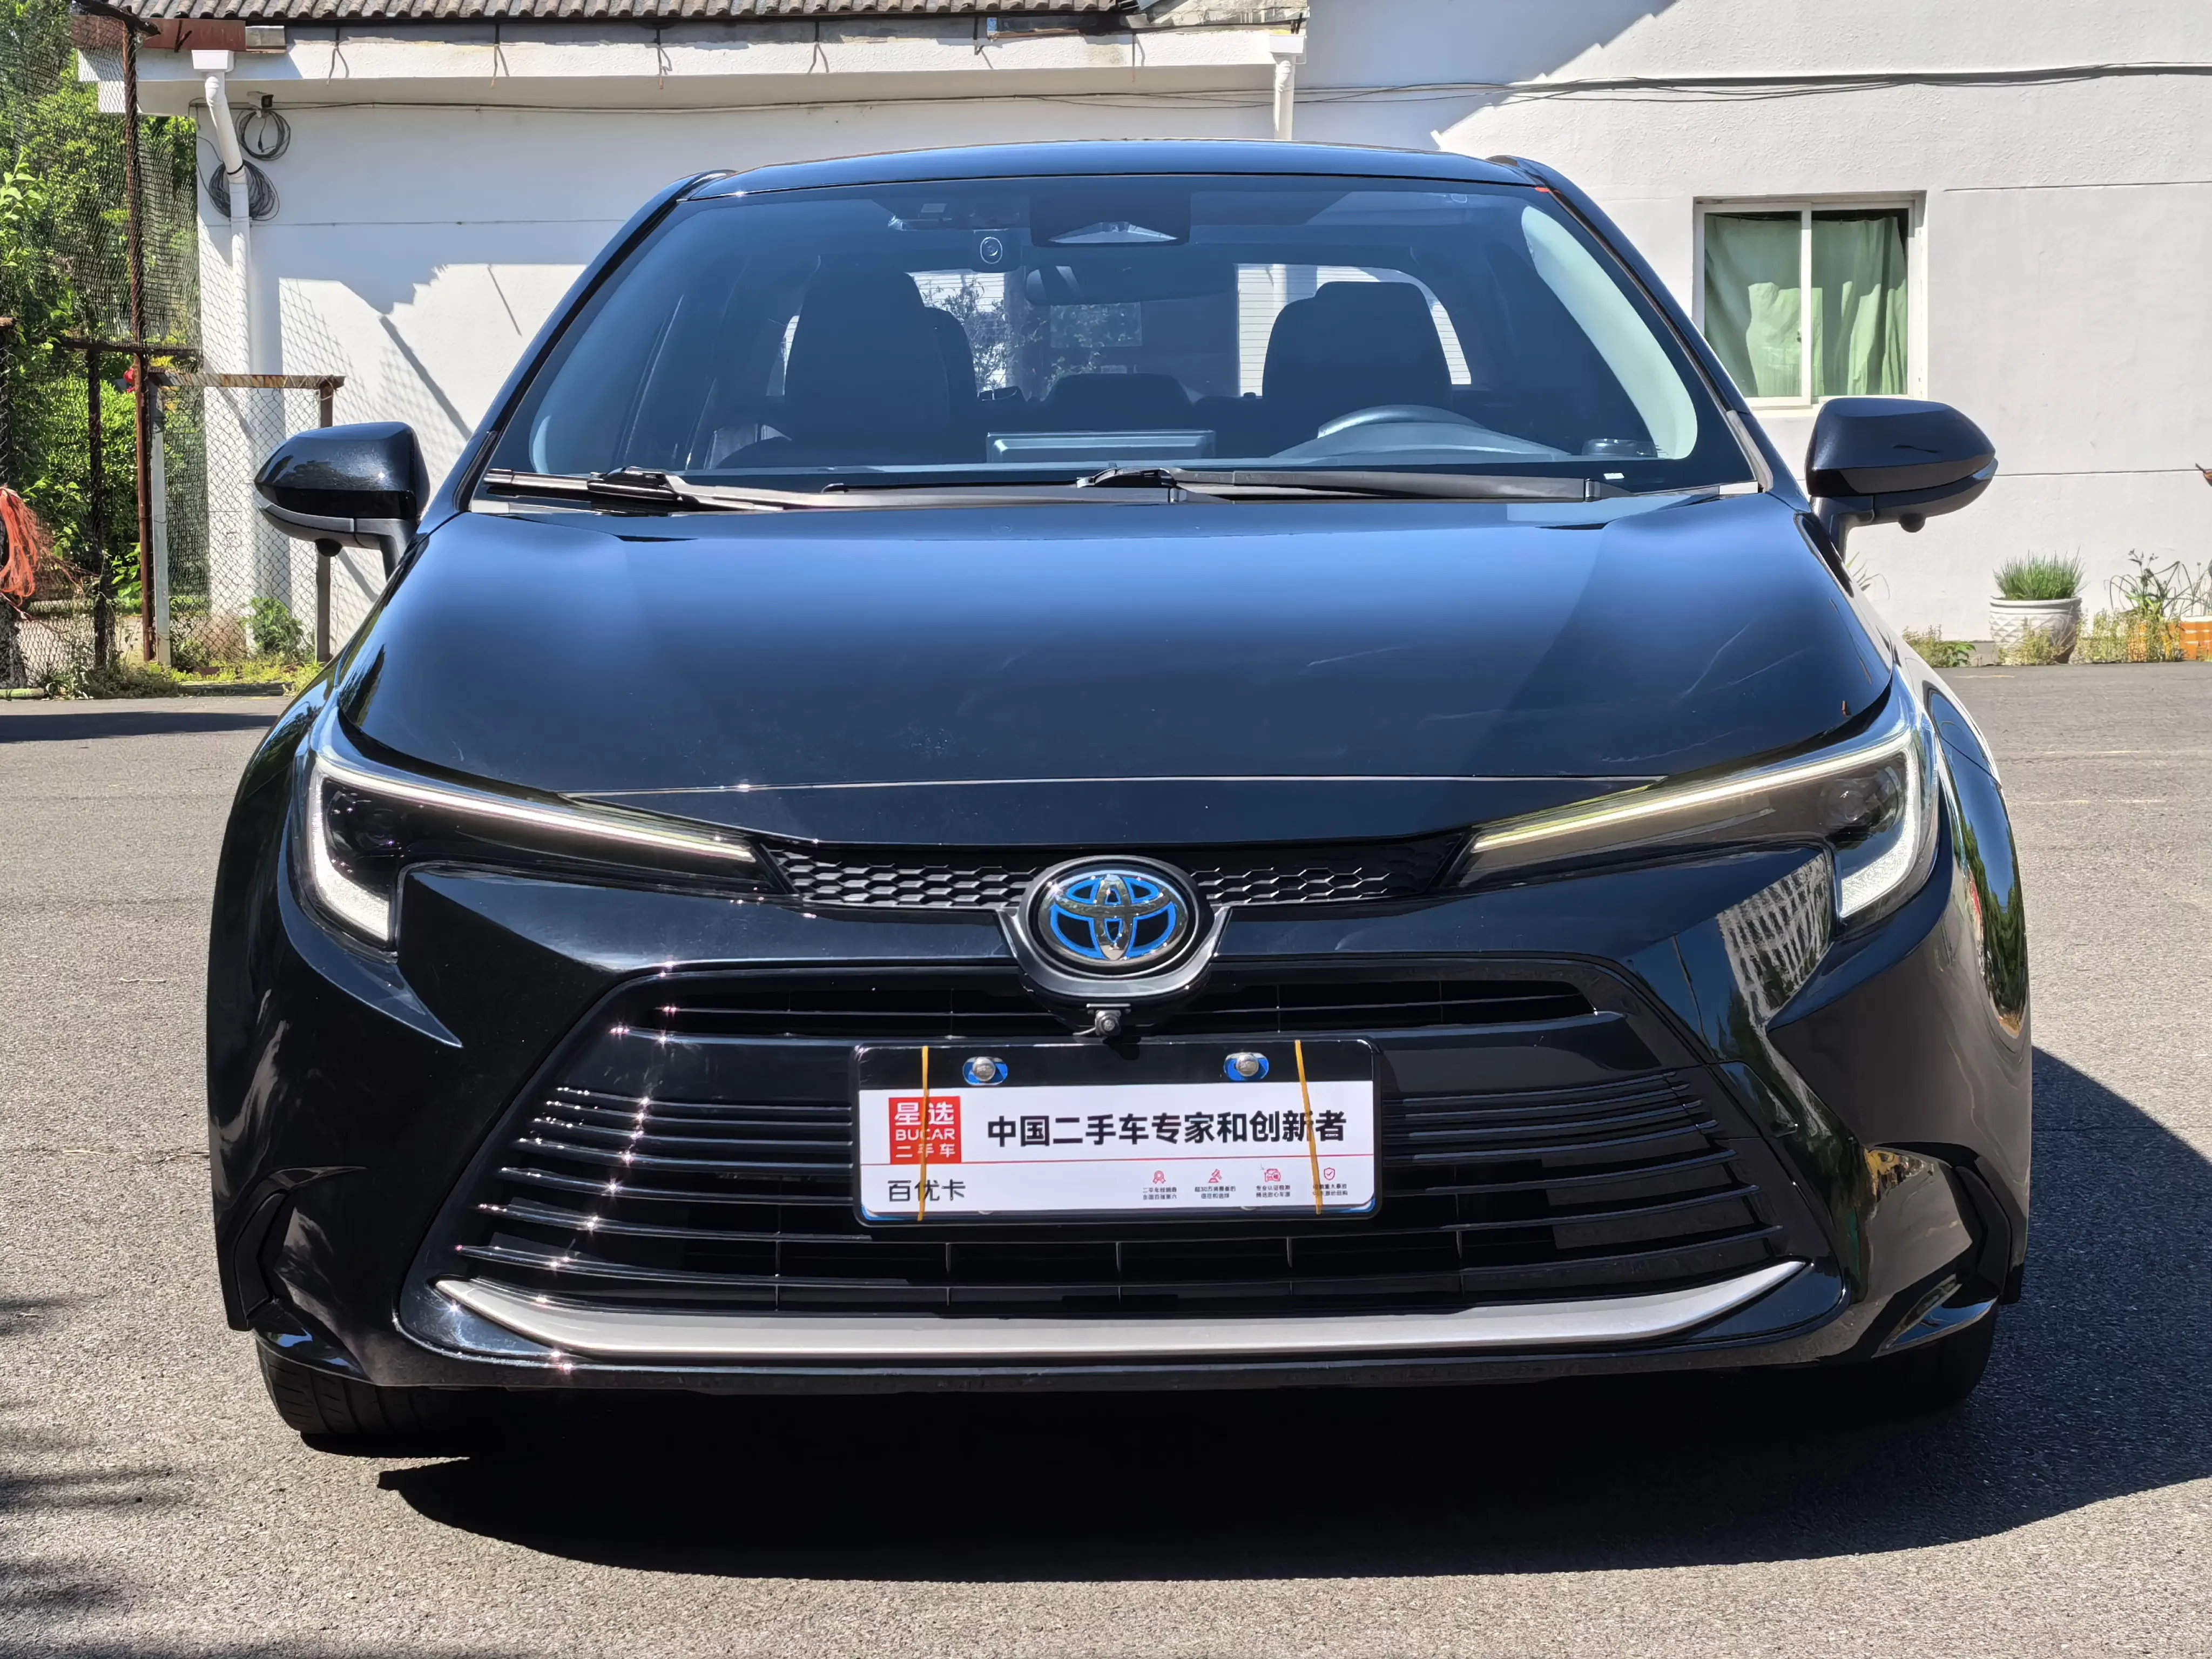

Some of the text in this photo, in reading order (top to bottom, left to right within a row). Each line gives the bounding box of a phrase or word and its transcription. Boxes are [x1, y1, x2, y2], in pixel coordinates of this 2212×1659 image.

[894, 1102, 954, 1125] 星选
[895, 1128, 955, 1141] BUCAR
[988, 1109, 1347, 1148] 中国二手车专家和创新者
[895, 1143, 955, 1158] 二手车
[888, 1179, 966, 1202] 百优卡
